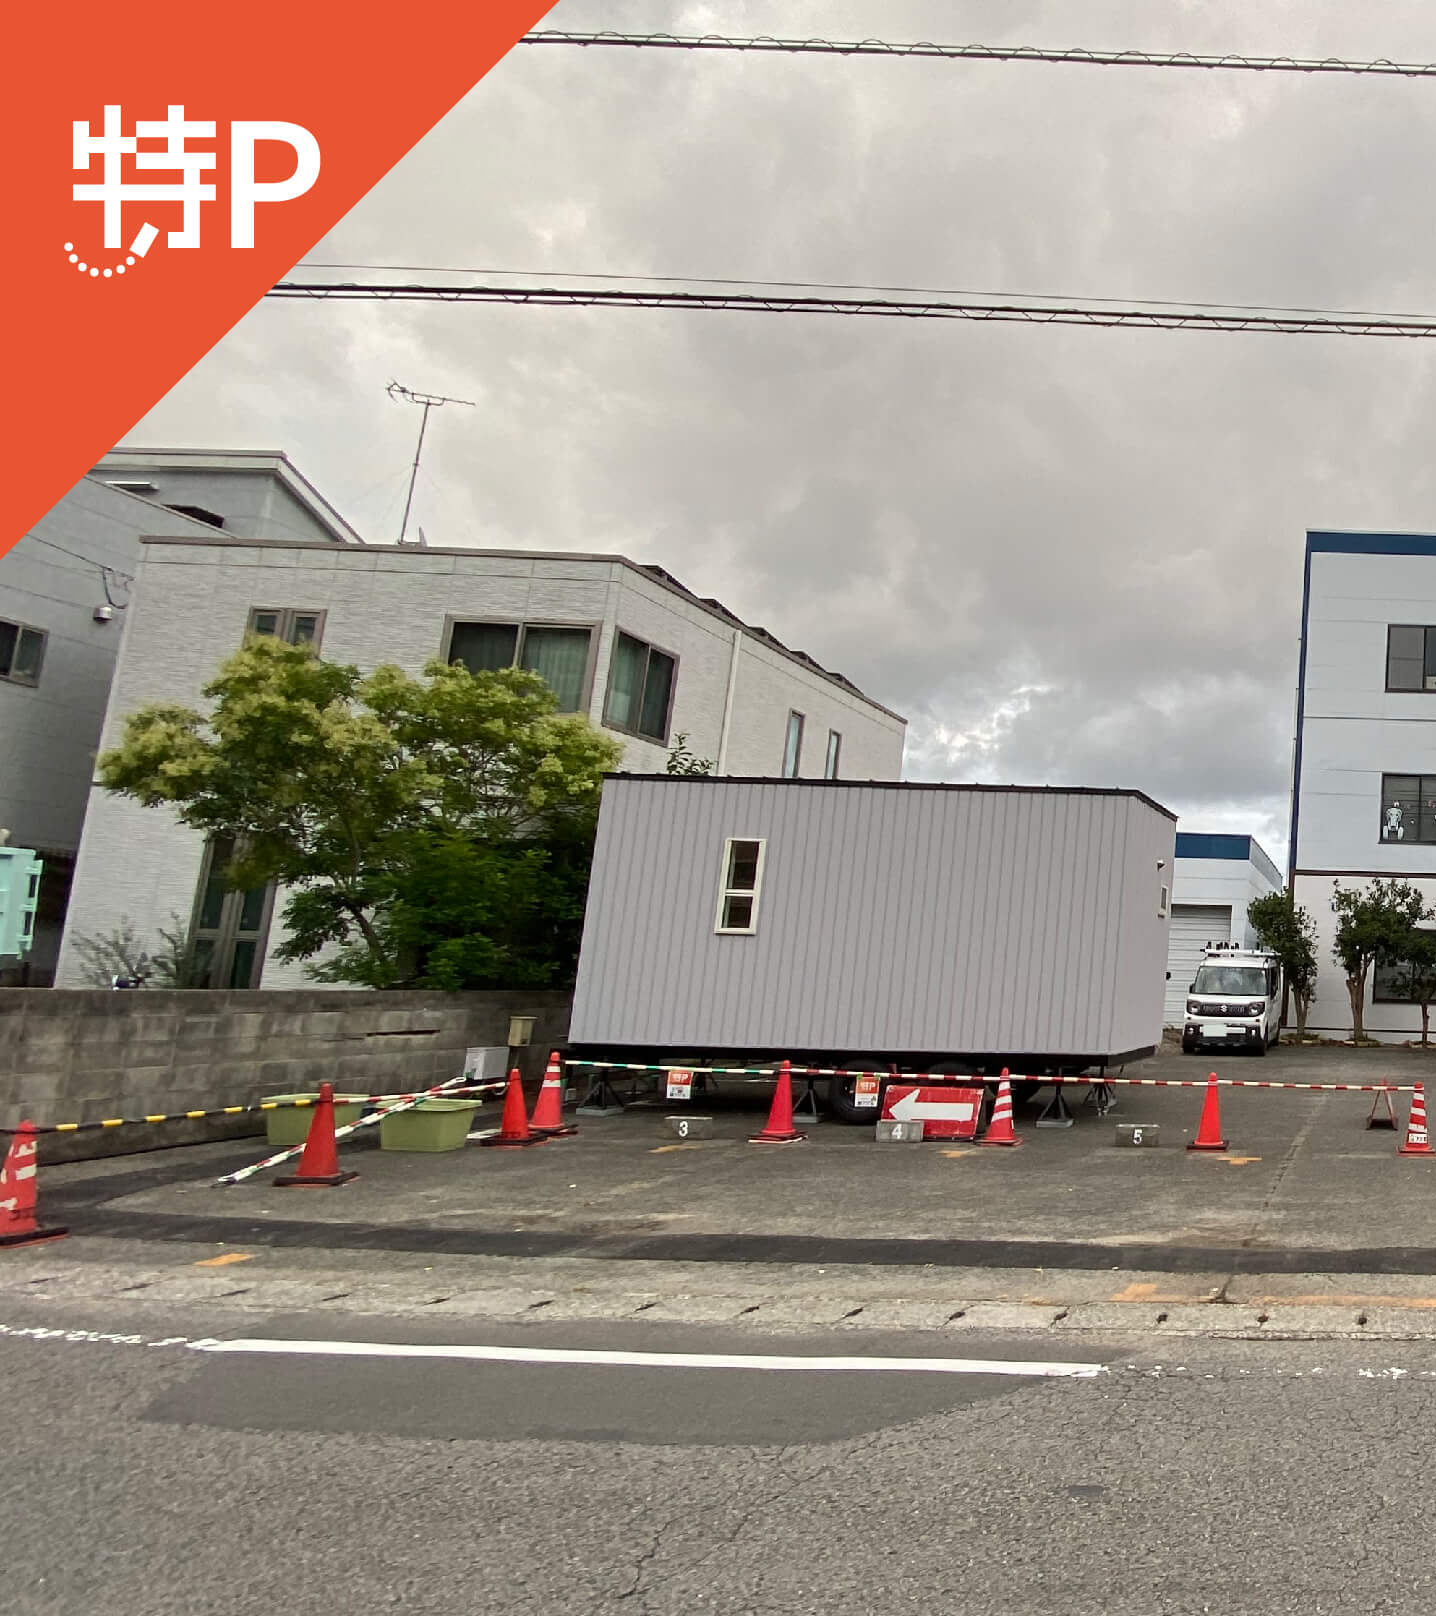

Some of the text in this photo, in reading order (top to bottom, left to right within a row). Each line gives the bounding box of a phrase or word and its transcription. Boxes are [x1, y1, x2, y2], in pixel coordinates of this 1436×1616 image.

[679, 1120, 689, 1137] 3
[891, 1123, 903, 1139] 4
[1133, 1129, 1143, 1144] 5
